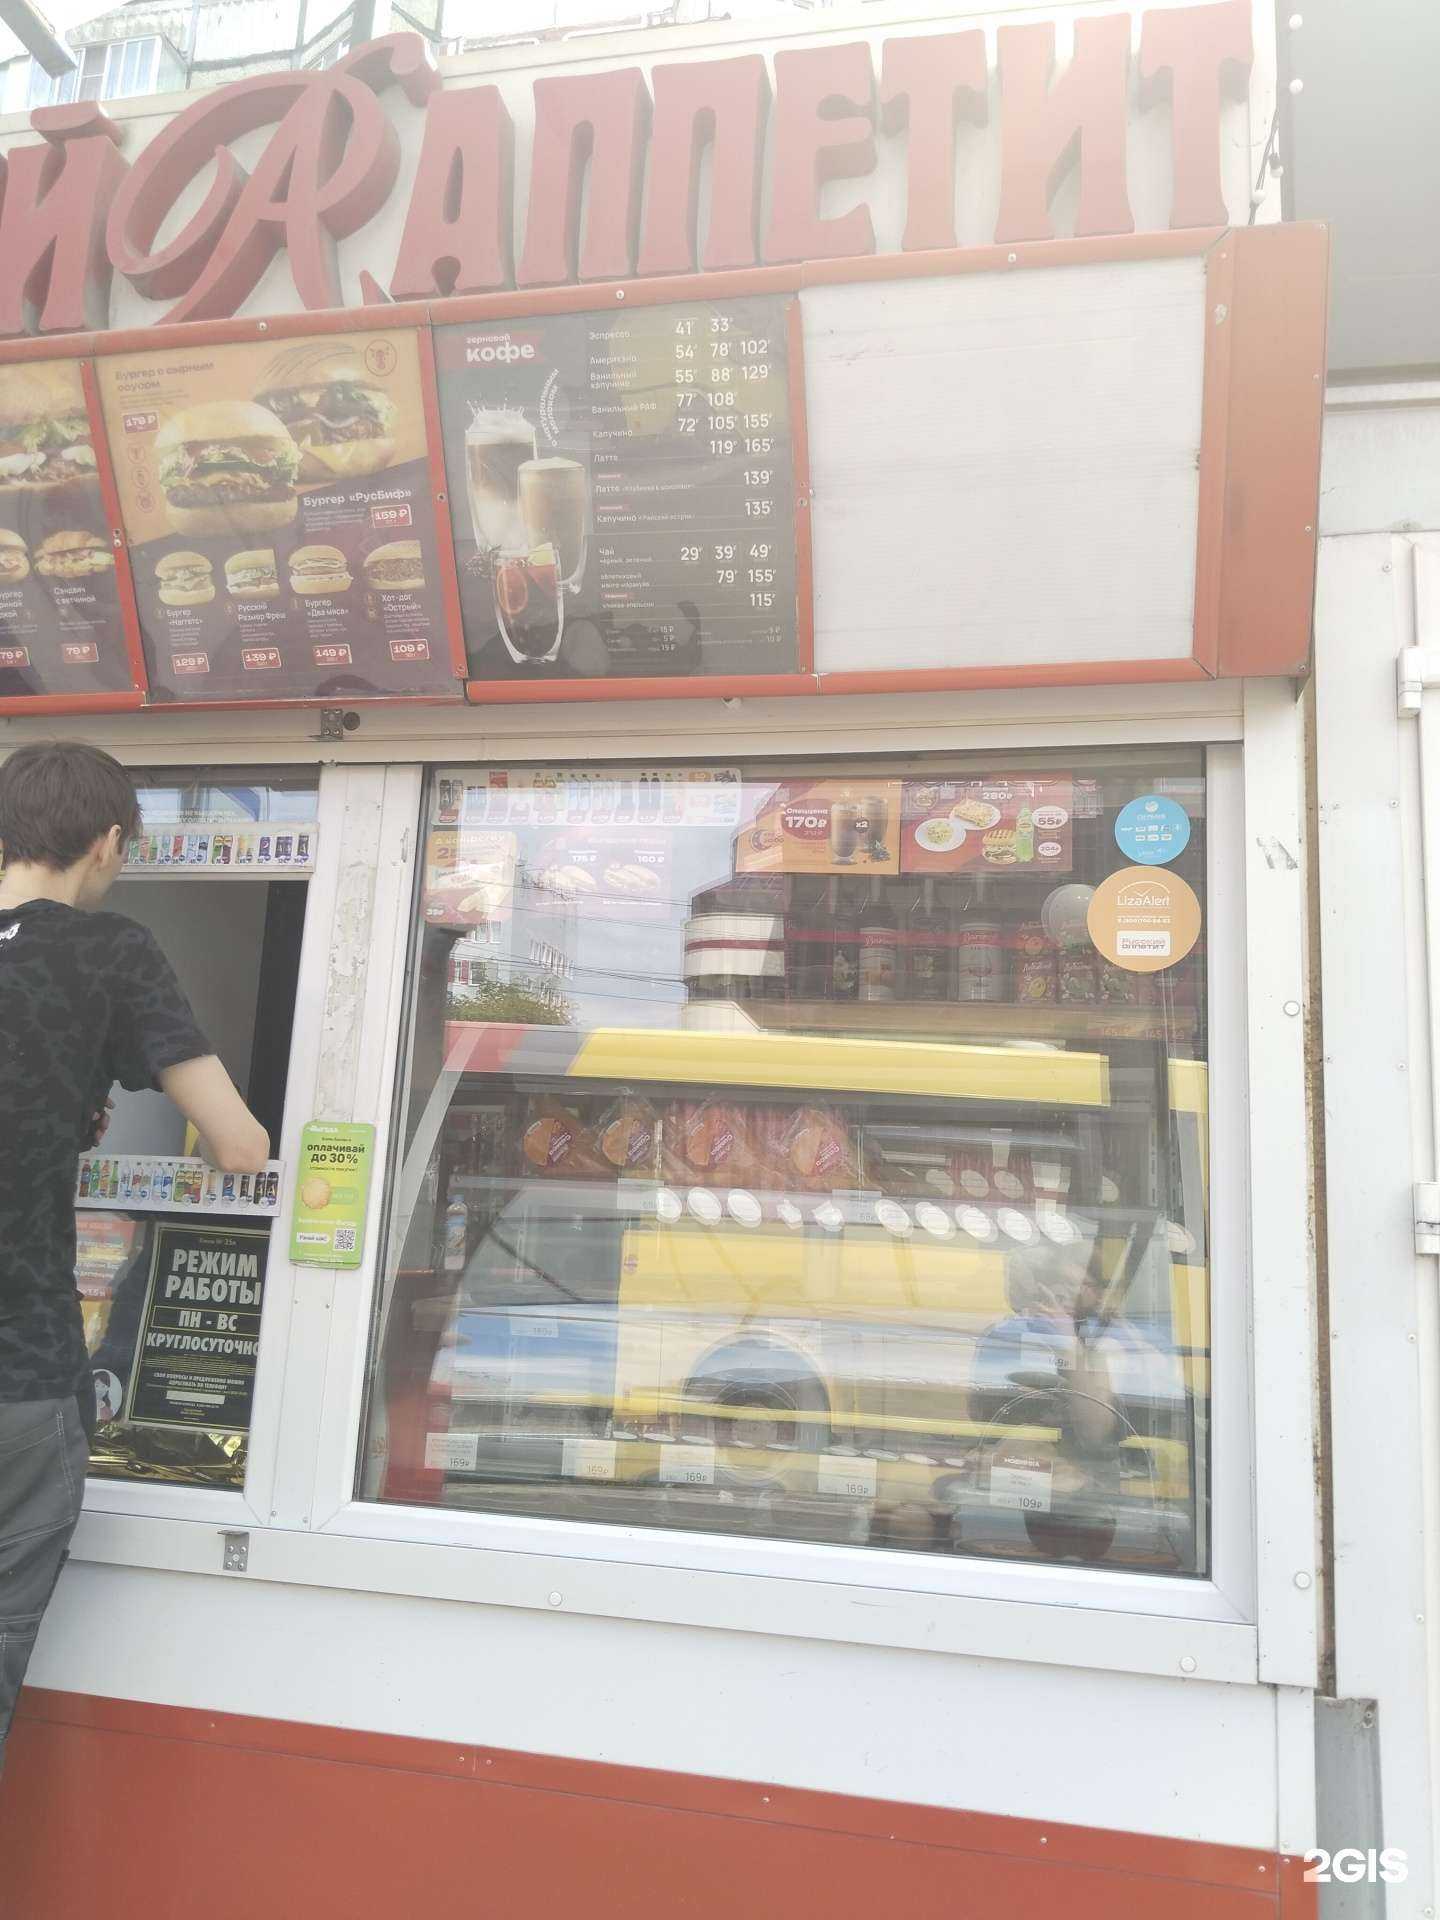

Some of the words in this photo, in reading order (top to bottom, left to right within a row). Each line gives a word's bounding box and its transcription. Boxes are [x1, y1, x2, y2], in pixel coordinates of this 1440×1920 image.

[388, 1, 1254, 300] АППЕТИТ
[466, 341, 536, 364] кофе
[593, 430, 633, 440] Капучино
[594, 454, 618, 463] Латте
[595, 484, 620, 494] Латте
[303, 495, 345, 508] Бургер
[599, 547, 615, 556] Чай
[1117, 895, 1170, 906] LizaAlert
[307, 1142, 365, 1153] оплачивай
[311, 1153, 327, 1163] до
[330, 1153, 358, 1164] 30%
[172, 1249, 258, 1278] РЕЖИМ
[165, 1275, 261, 1305] РАБОТЫ
[178, 1310, 201, 1328] ПН
[217, 1313, 239, 1332] ВС
